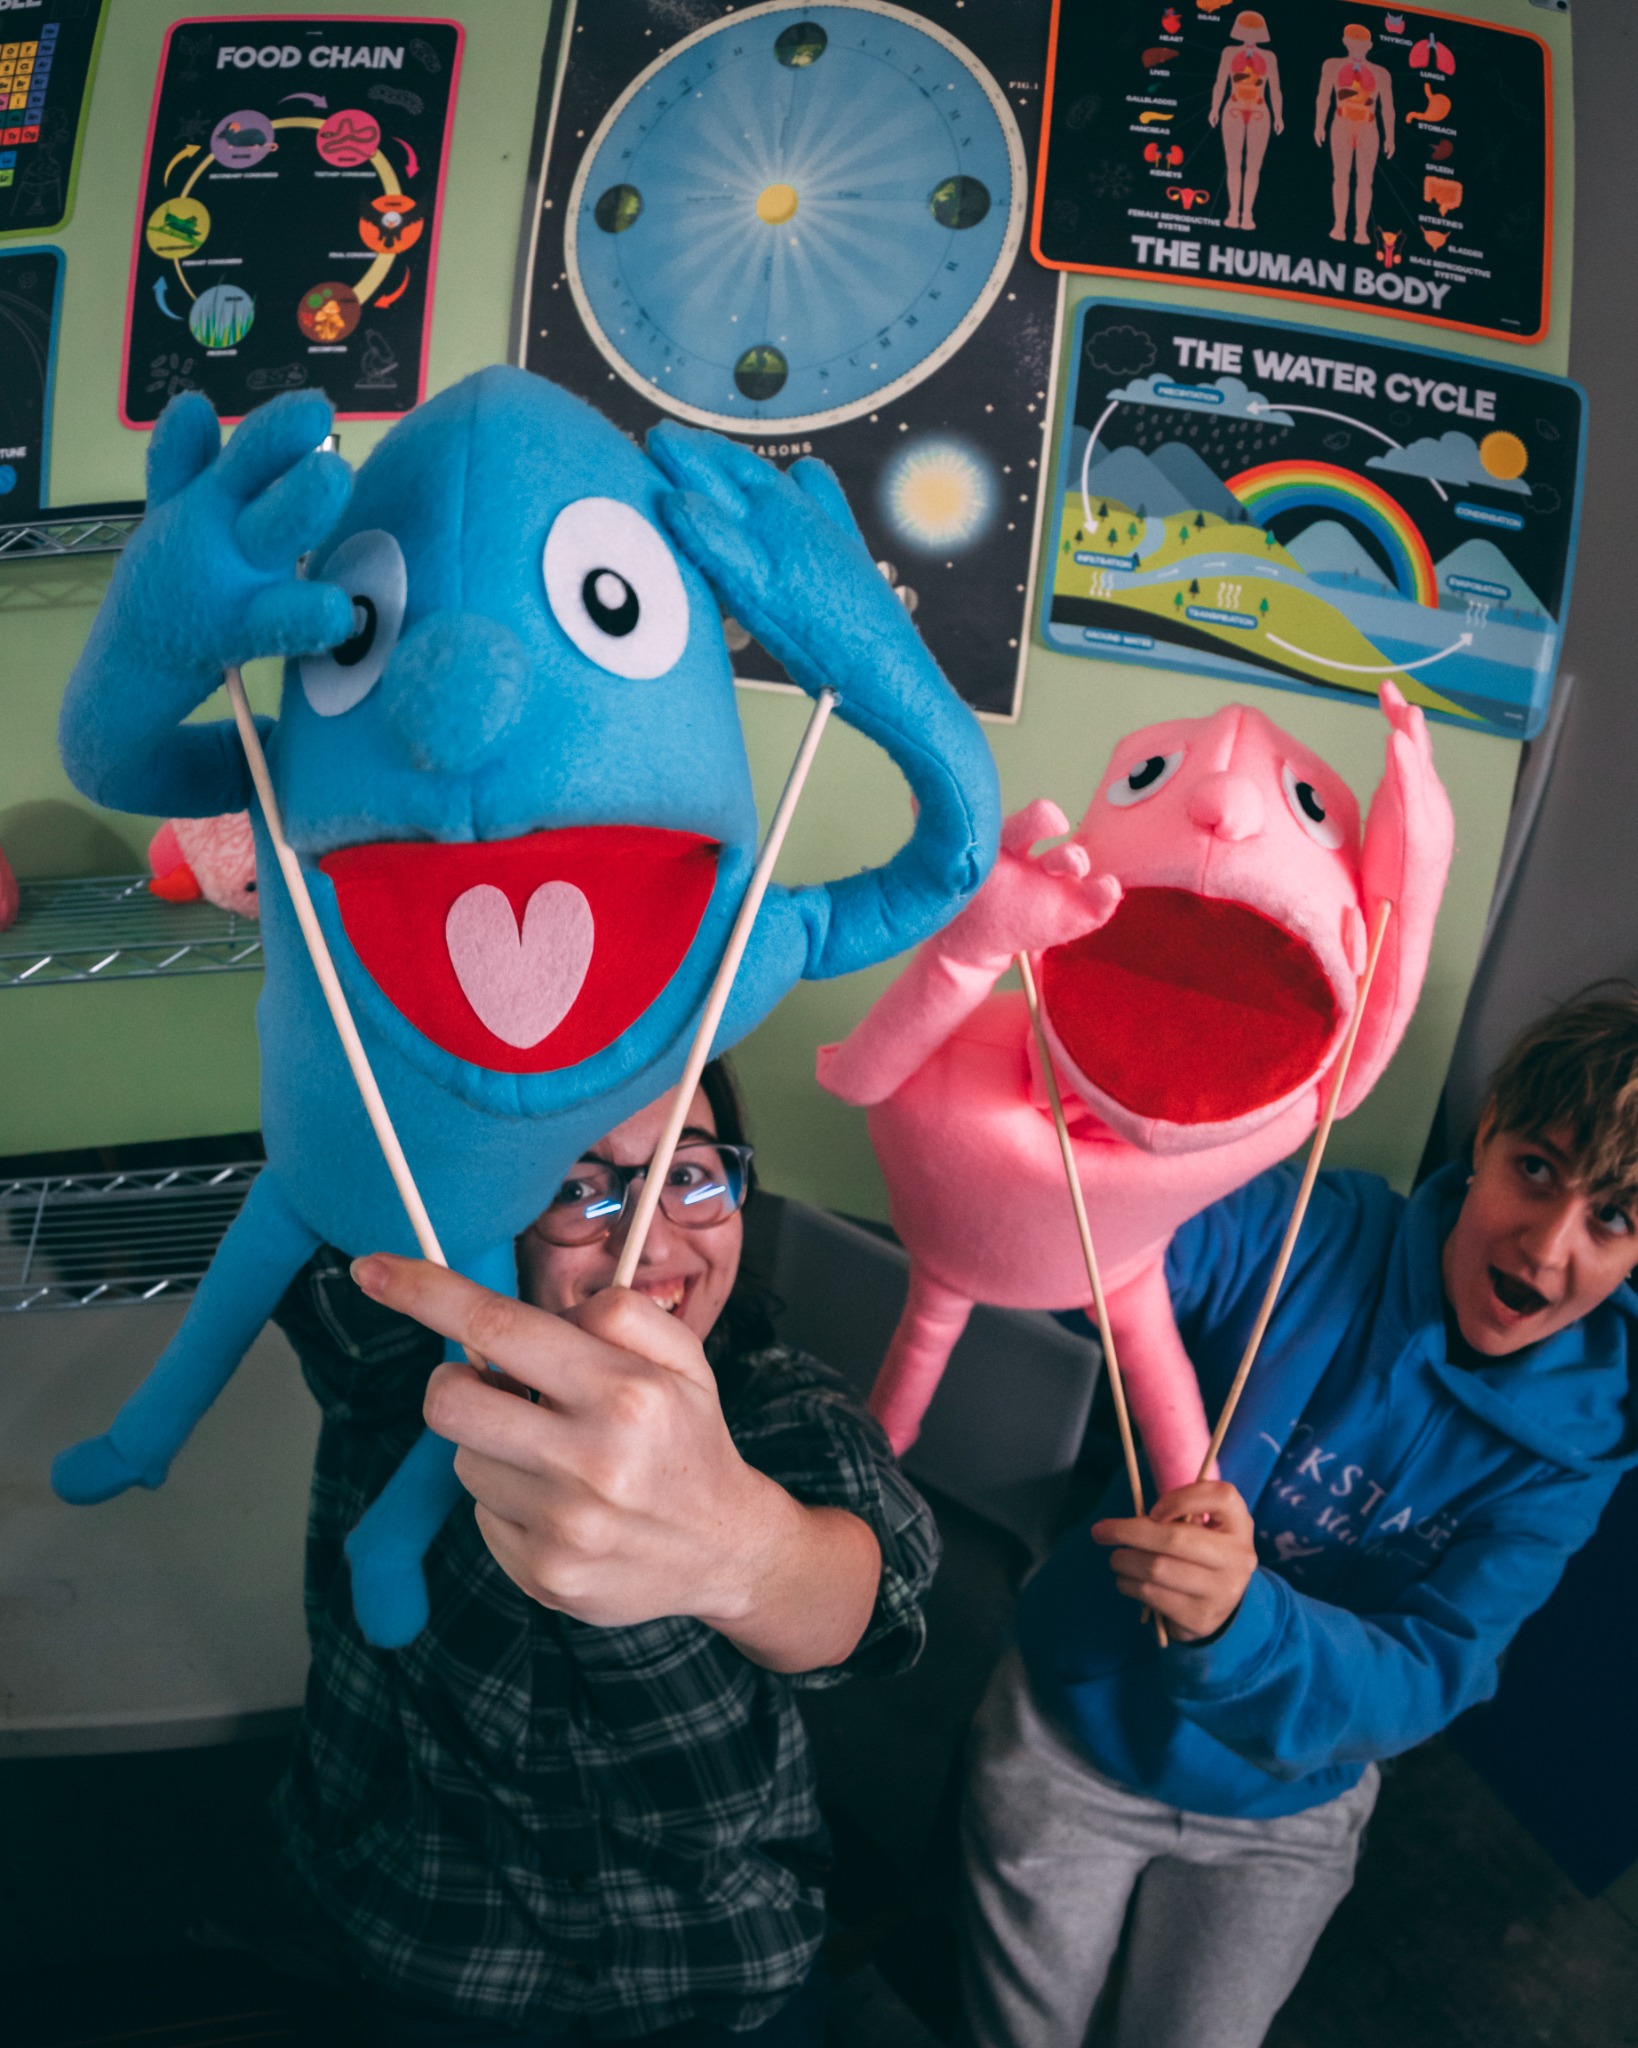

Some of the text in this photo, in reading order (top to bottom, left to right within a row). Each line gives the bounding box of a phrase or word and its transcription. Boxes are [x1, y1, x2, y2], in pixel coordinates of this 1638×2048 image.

[1197, 13, 1220, 21] BRAIN
[1159, 34, 1183, 42] HEART
[1379, 34, 1413, 46] THYROID
[216, 45, 405, 70] FOOD CHAIN
[1149, 68, 1170, 77] LIVER
[1420, 71, 1445, 81] LUNGS
[1126, 94, 1177, 106] GALLBLADDER
[1129, 124, 1170, 135] PANCREAS
[1418, 122, 1457, 136] STOMACH
[1149, 168, 1182, 178] KIDNEYS
[1425, 163, 1454, 175] SPLEEN
[1128, 208, 1221, 227] FEMALE REPRODUCTIVE
[1418, 214, 1464, 230] INTESTINES
[1157, 221, 1190, 232] SYSTEM
[1448, 245, 1484, 259] BLADDER
[1131, 234, 1451, 310] THE HUMAN BODY
[1409, 255, 1491, 279] MALE REPRODUCTIVE
[1434, 270, 1466, 283] SYSTEM
[1172, 336, 1497, 421] THE WATER CYCLE
[1158, 386, 1220, 403] PRECIPITATION
[1455, 507, 1522, 528] CONDENSATION
[1076, 553, 1133, 569] INFILTRATION
[1449, 577, 1508, 597] EVAPORATION
[1188, 608, 1255, 626] TRANSPIRATION
[1085, 630, 1151, 647] GROUND WATER
